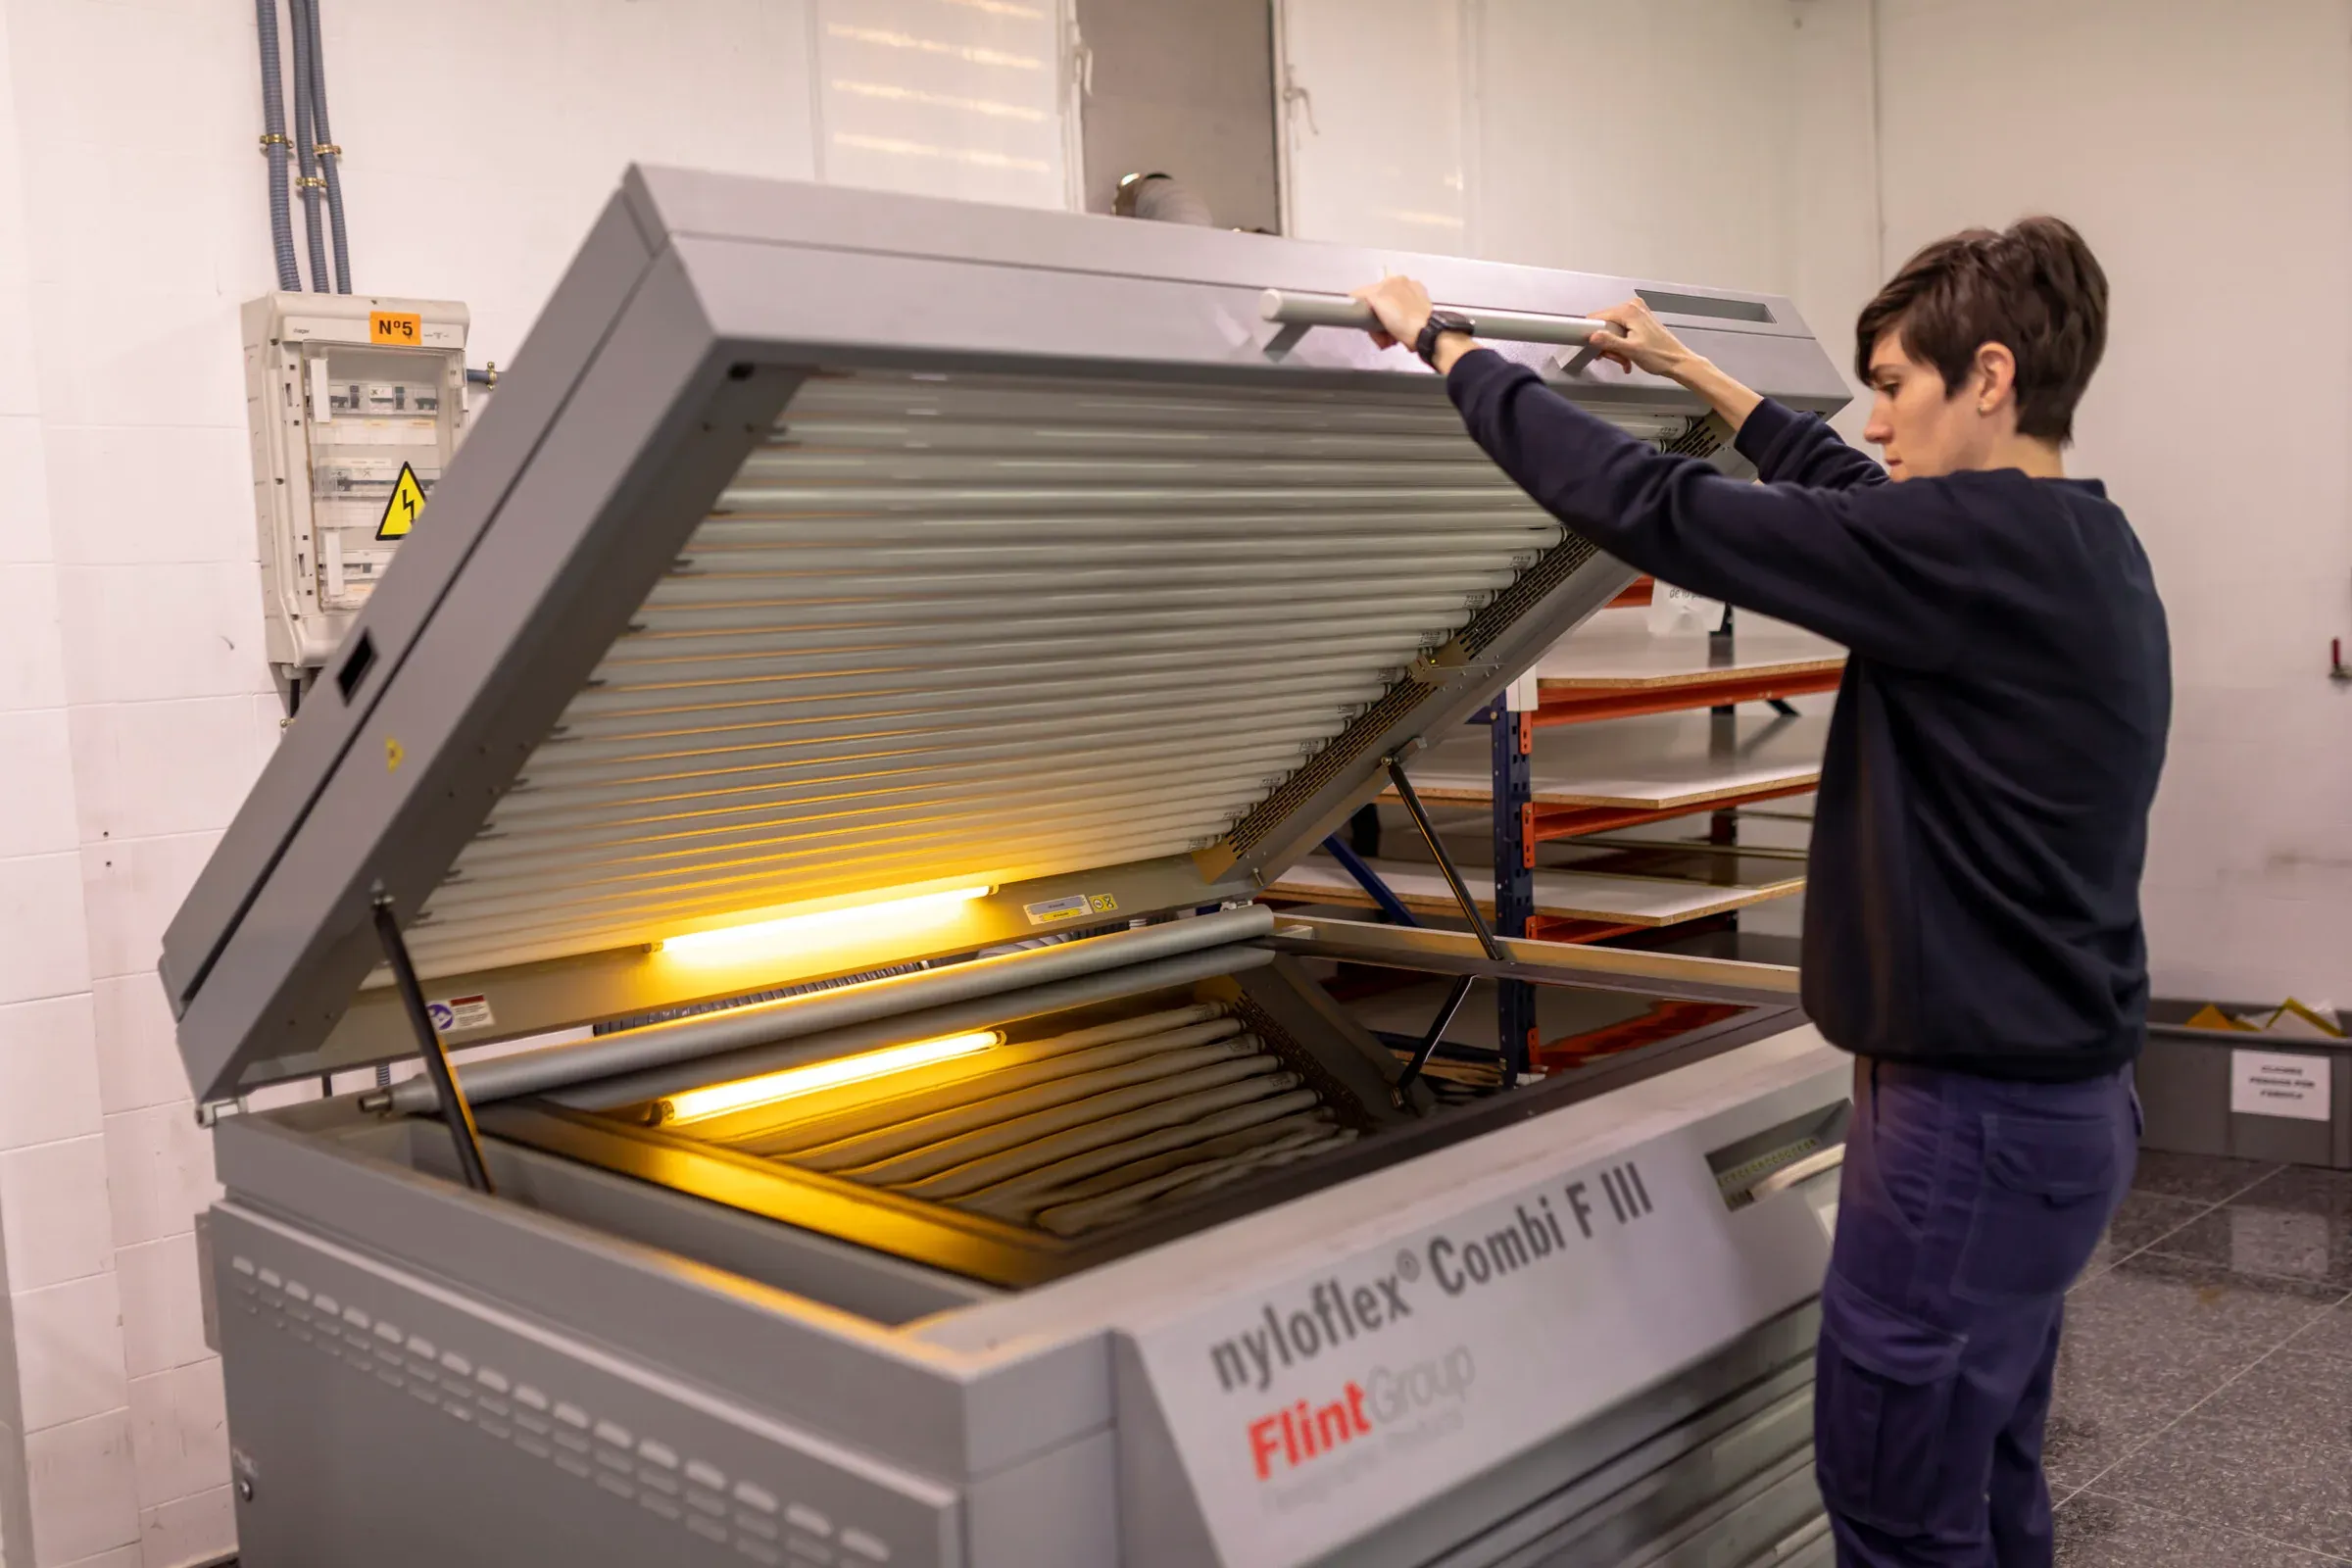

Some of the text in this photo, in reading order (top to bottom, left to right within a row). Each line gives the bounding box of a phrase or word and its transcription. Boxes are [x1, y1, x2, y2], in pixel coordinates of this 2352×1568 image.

[1428, 1195, 1566, 1297] Combi
[1565, 1181, 1592, 1240] F
[1600, 1161, 1653, 1225] III
